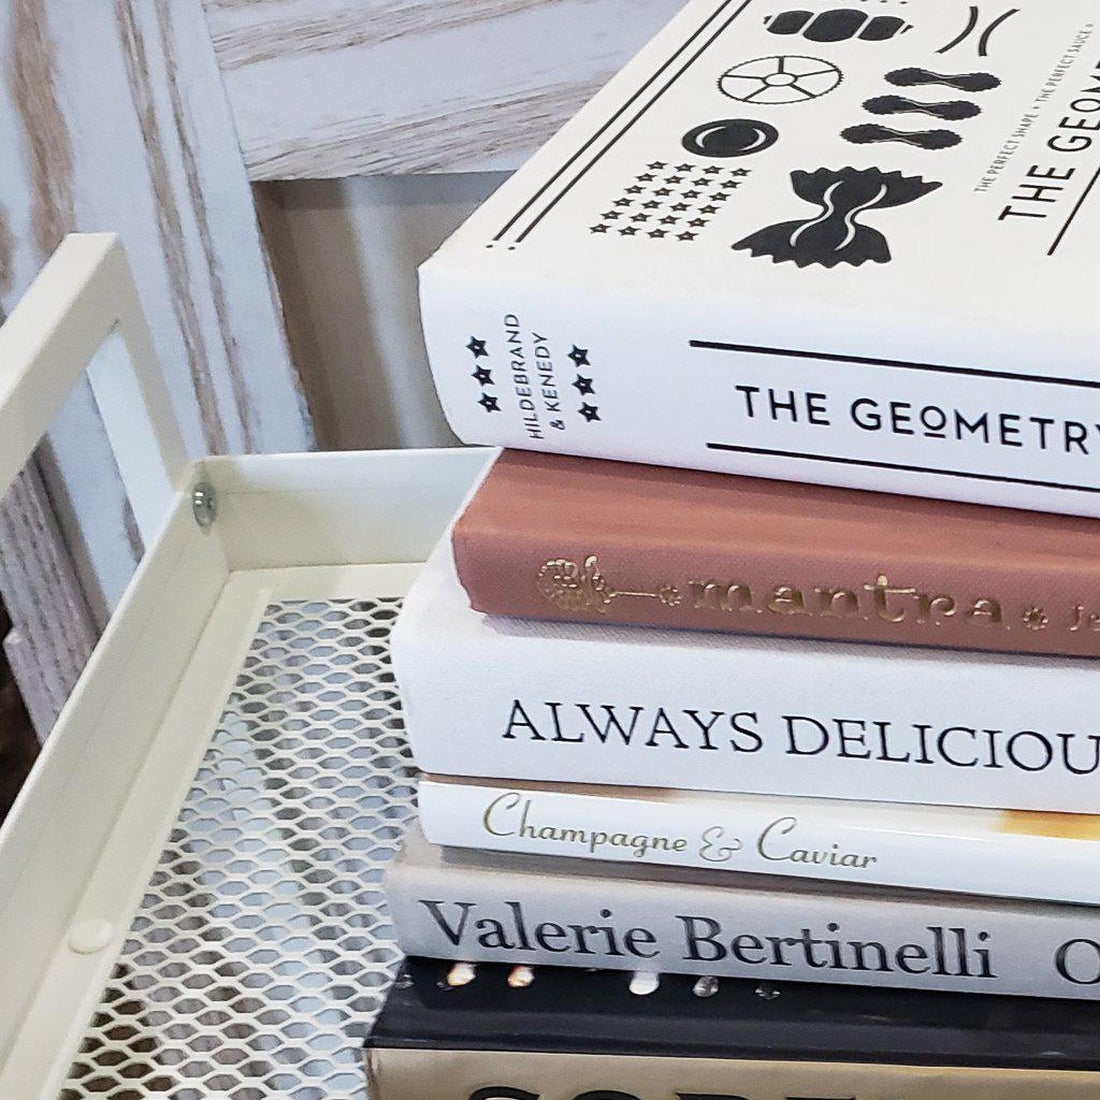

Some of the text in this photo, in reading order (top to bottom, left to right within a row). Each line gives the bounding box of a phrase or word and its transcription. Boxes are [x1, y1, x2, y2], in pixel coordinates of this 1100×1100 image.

[998, 165, 1076, 221] THE
[504, 314, 545, 439] HILDEBRAND
[532, 332, 565, 430] & KENEDY
[735, 384, 831, 427] THE
[690, 574, 1011, 630] mantra
[502, 700, 762, 753] ALWAYS
[483, 792, 878, 869] Champagne & Caviar
[418, 899, 997, 979] Valerie Bertinelli
